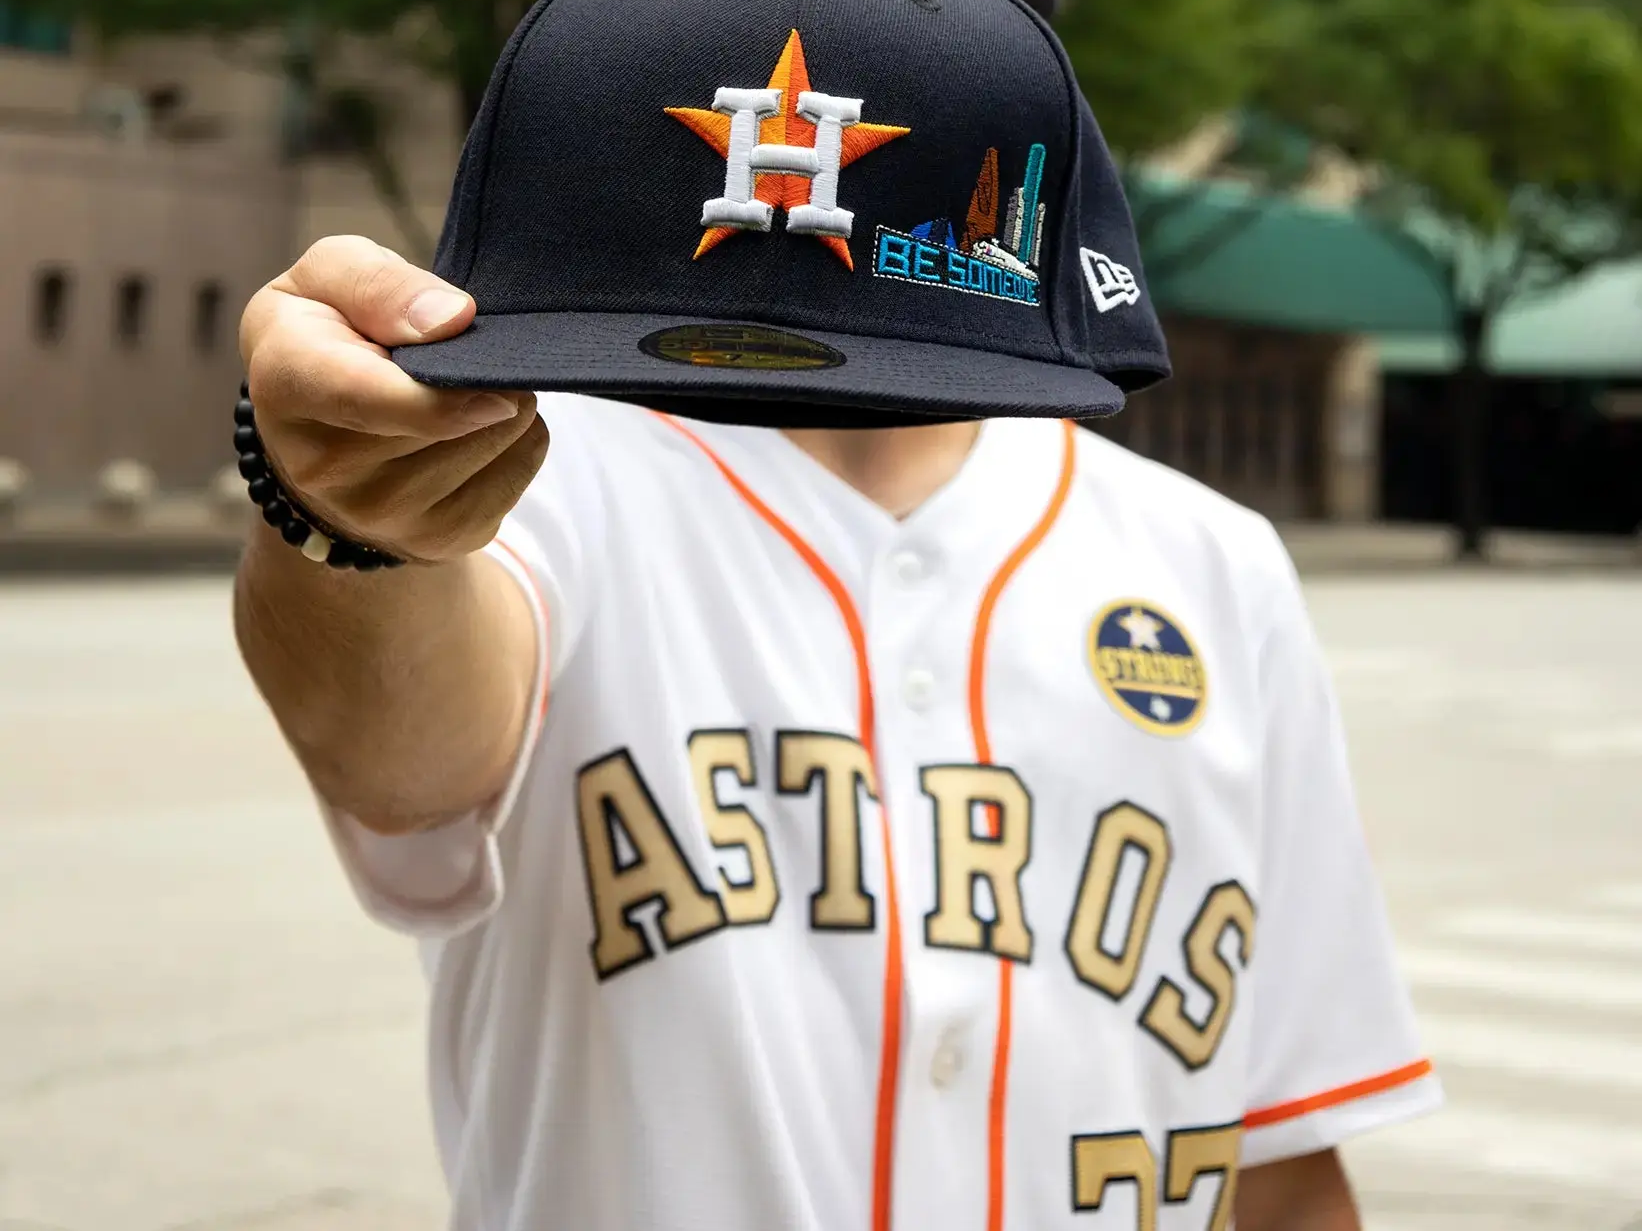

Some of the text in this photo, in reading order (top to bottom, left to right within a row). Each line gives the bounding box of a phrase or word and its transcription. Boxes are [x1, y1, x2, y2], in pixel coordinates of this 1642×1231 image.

[701, 86, 865, 239] H
[877, 232, 941, 282] BE
[574, 728, 1258, 1072] ASTROS
